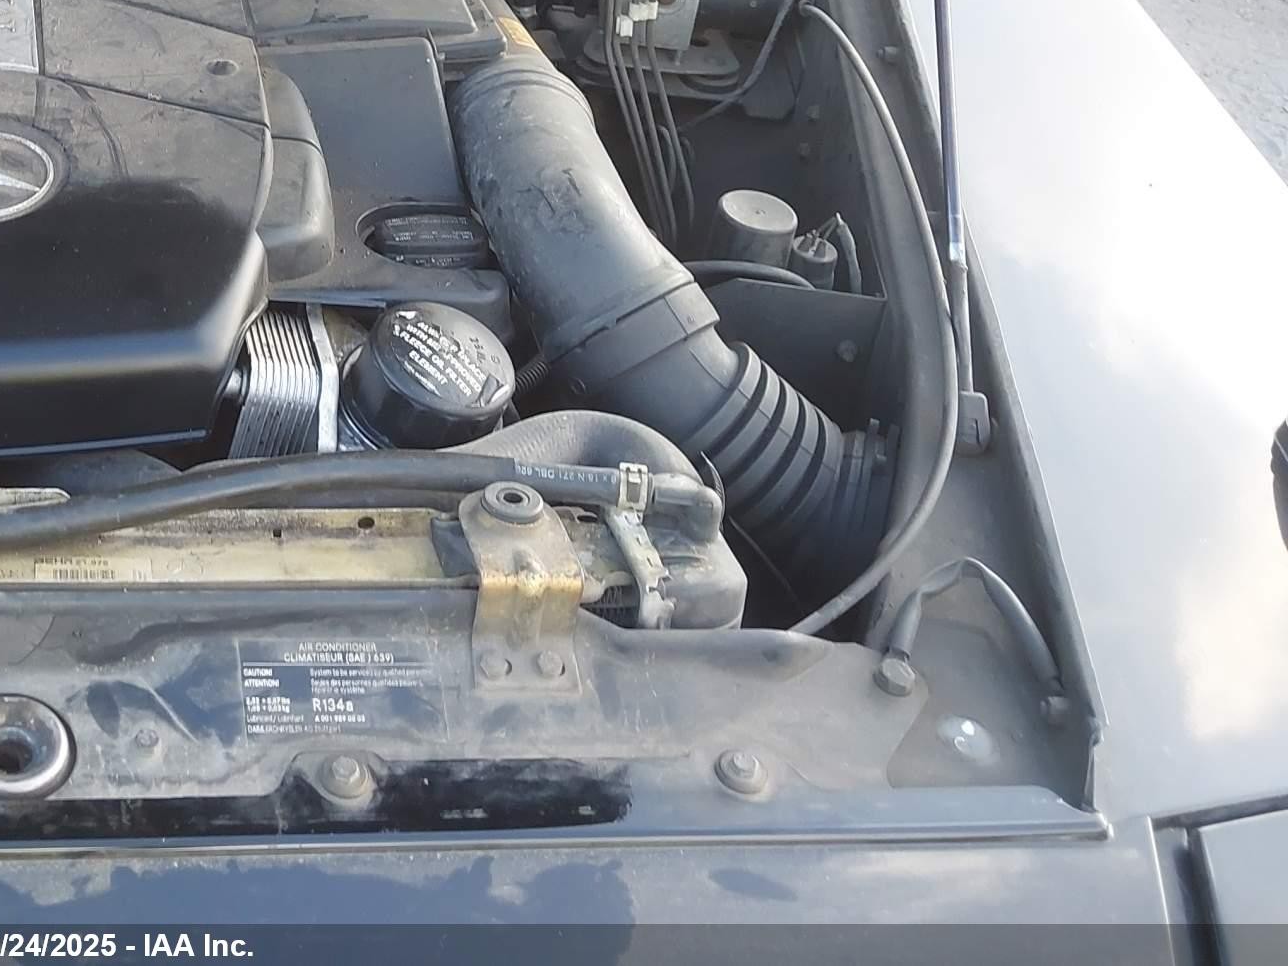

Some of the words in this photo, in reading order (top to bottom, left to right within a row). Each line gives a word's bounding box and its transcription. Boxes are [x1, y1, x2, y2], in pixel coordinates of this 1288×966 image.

[400, 330, 433, 359] FLEECE
[432, 354, 446, 371] OIL
[445, 366, 473, 397] FILTER
[409, 350, 448, 386] ELEMENT
[298, 642, 312, 652] AIR
[315, 642, 377, 652] CONDITIONER
[283, 653, 343, 663] CLIMATISEUR
[312, 697, 353, 712] R134a
